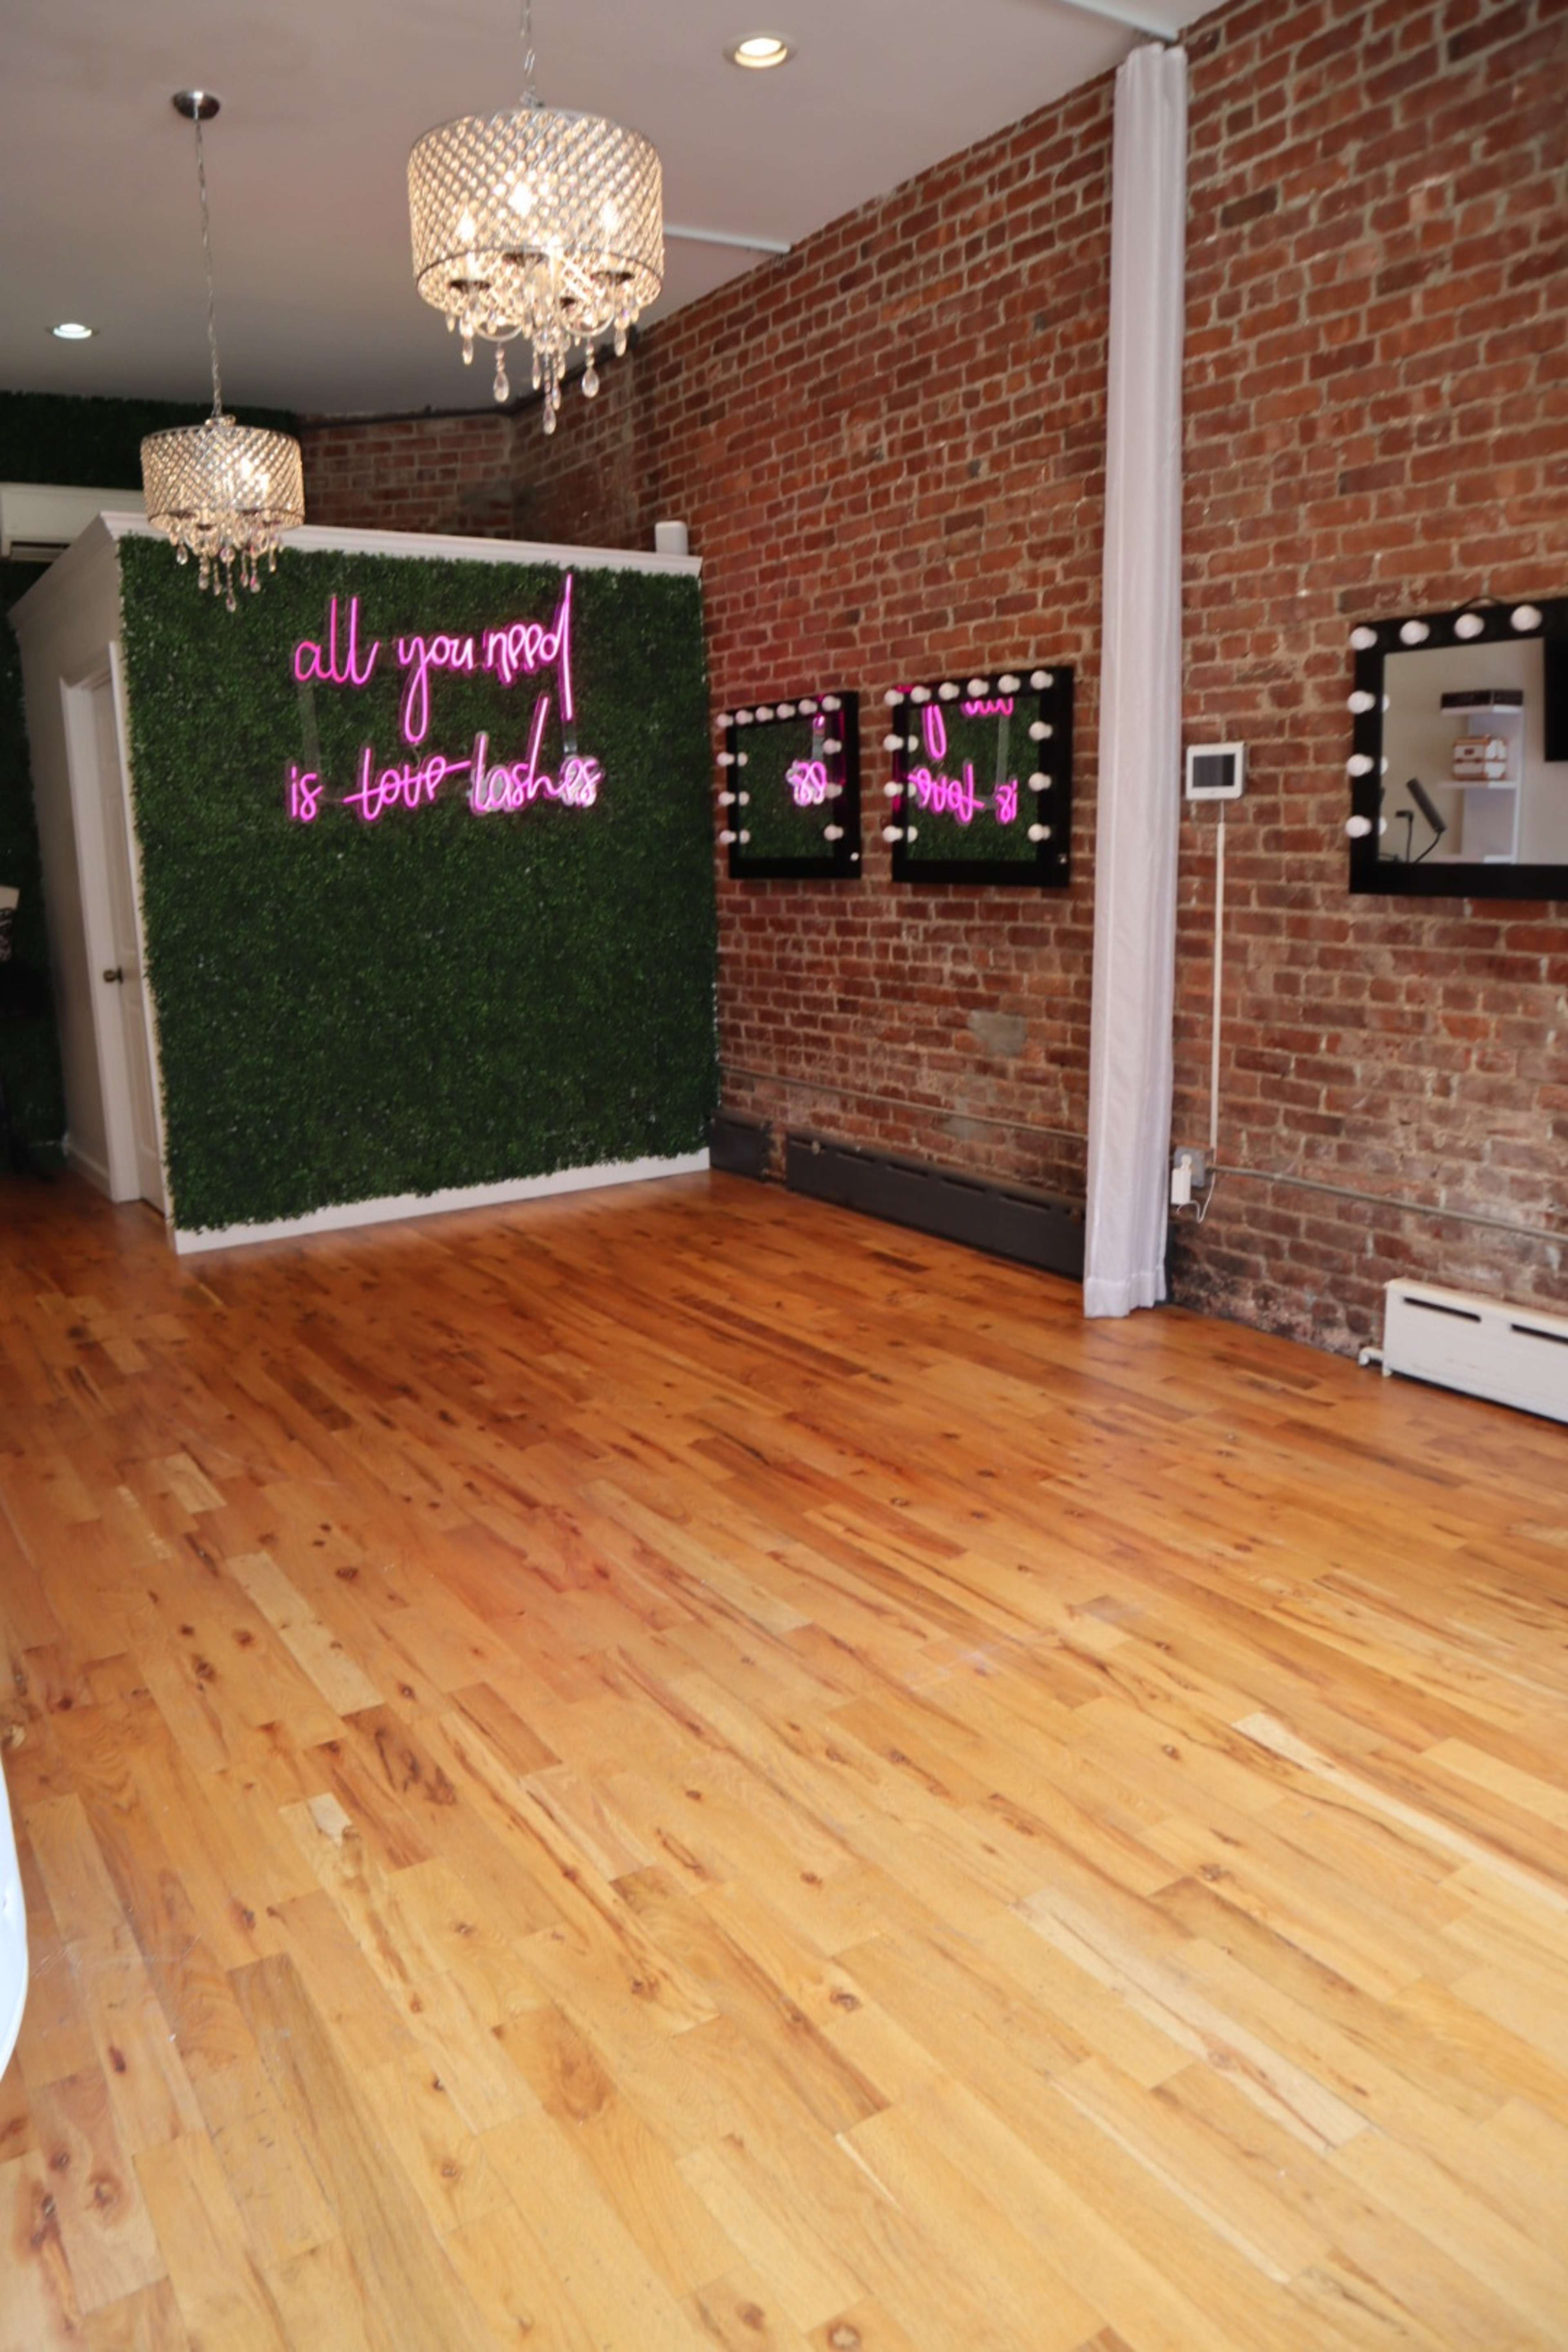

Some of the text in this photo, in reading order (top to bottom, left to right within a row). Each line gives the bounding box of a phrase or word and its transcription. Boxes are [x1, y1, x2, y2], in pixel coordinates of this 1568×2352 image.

[294, 573, 572, 745] all you need
[290, 696, 602, 821] is love lashes
